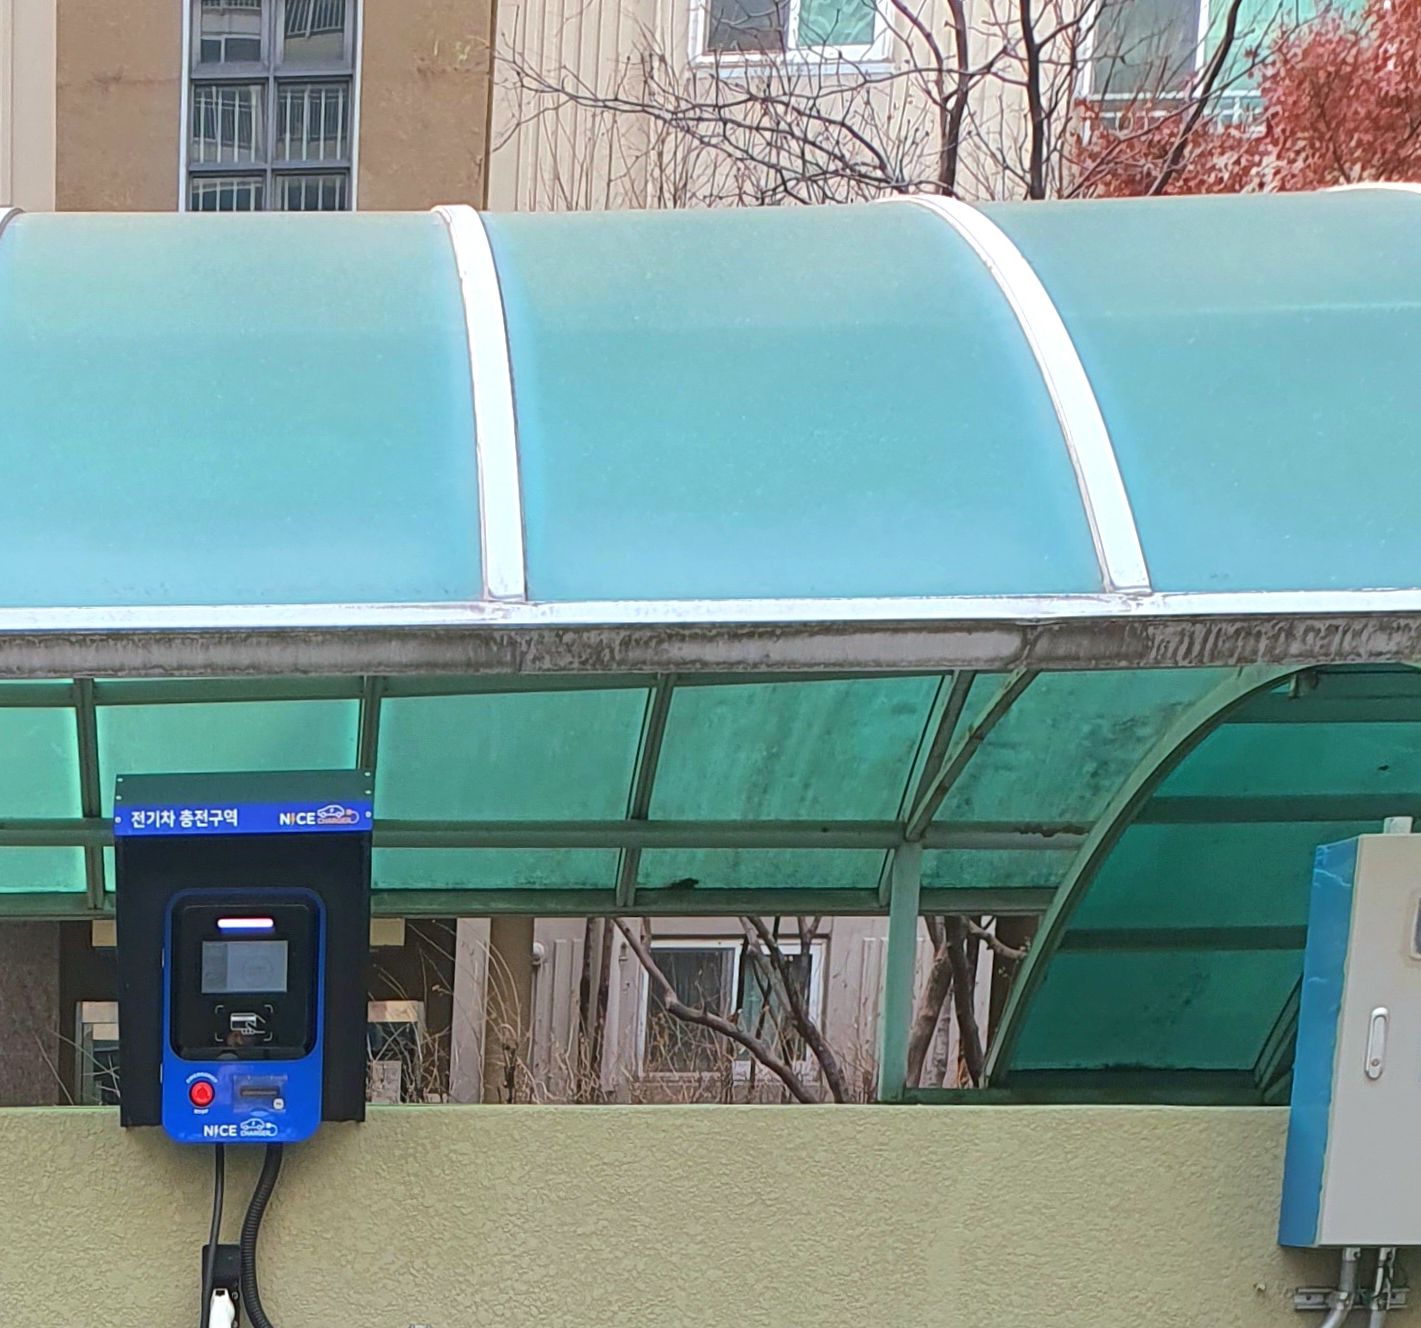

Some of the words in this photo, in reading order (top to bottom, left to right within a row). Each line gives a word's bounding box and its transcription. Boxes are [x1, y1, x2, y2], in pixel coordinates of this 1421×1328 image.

[131, 810, 175, 828] 전기차
[179, 809, 238, 828] 충전구역
[279, 812, 315, 825] NICE
[203, 1125, 237, 1138] NICE
